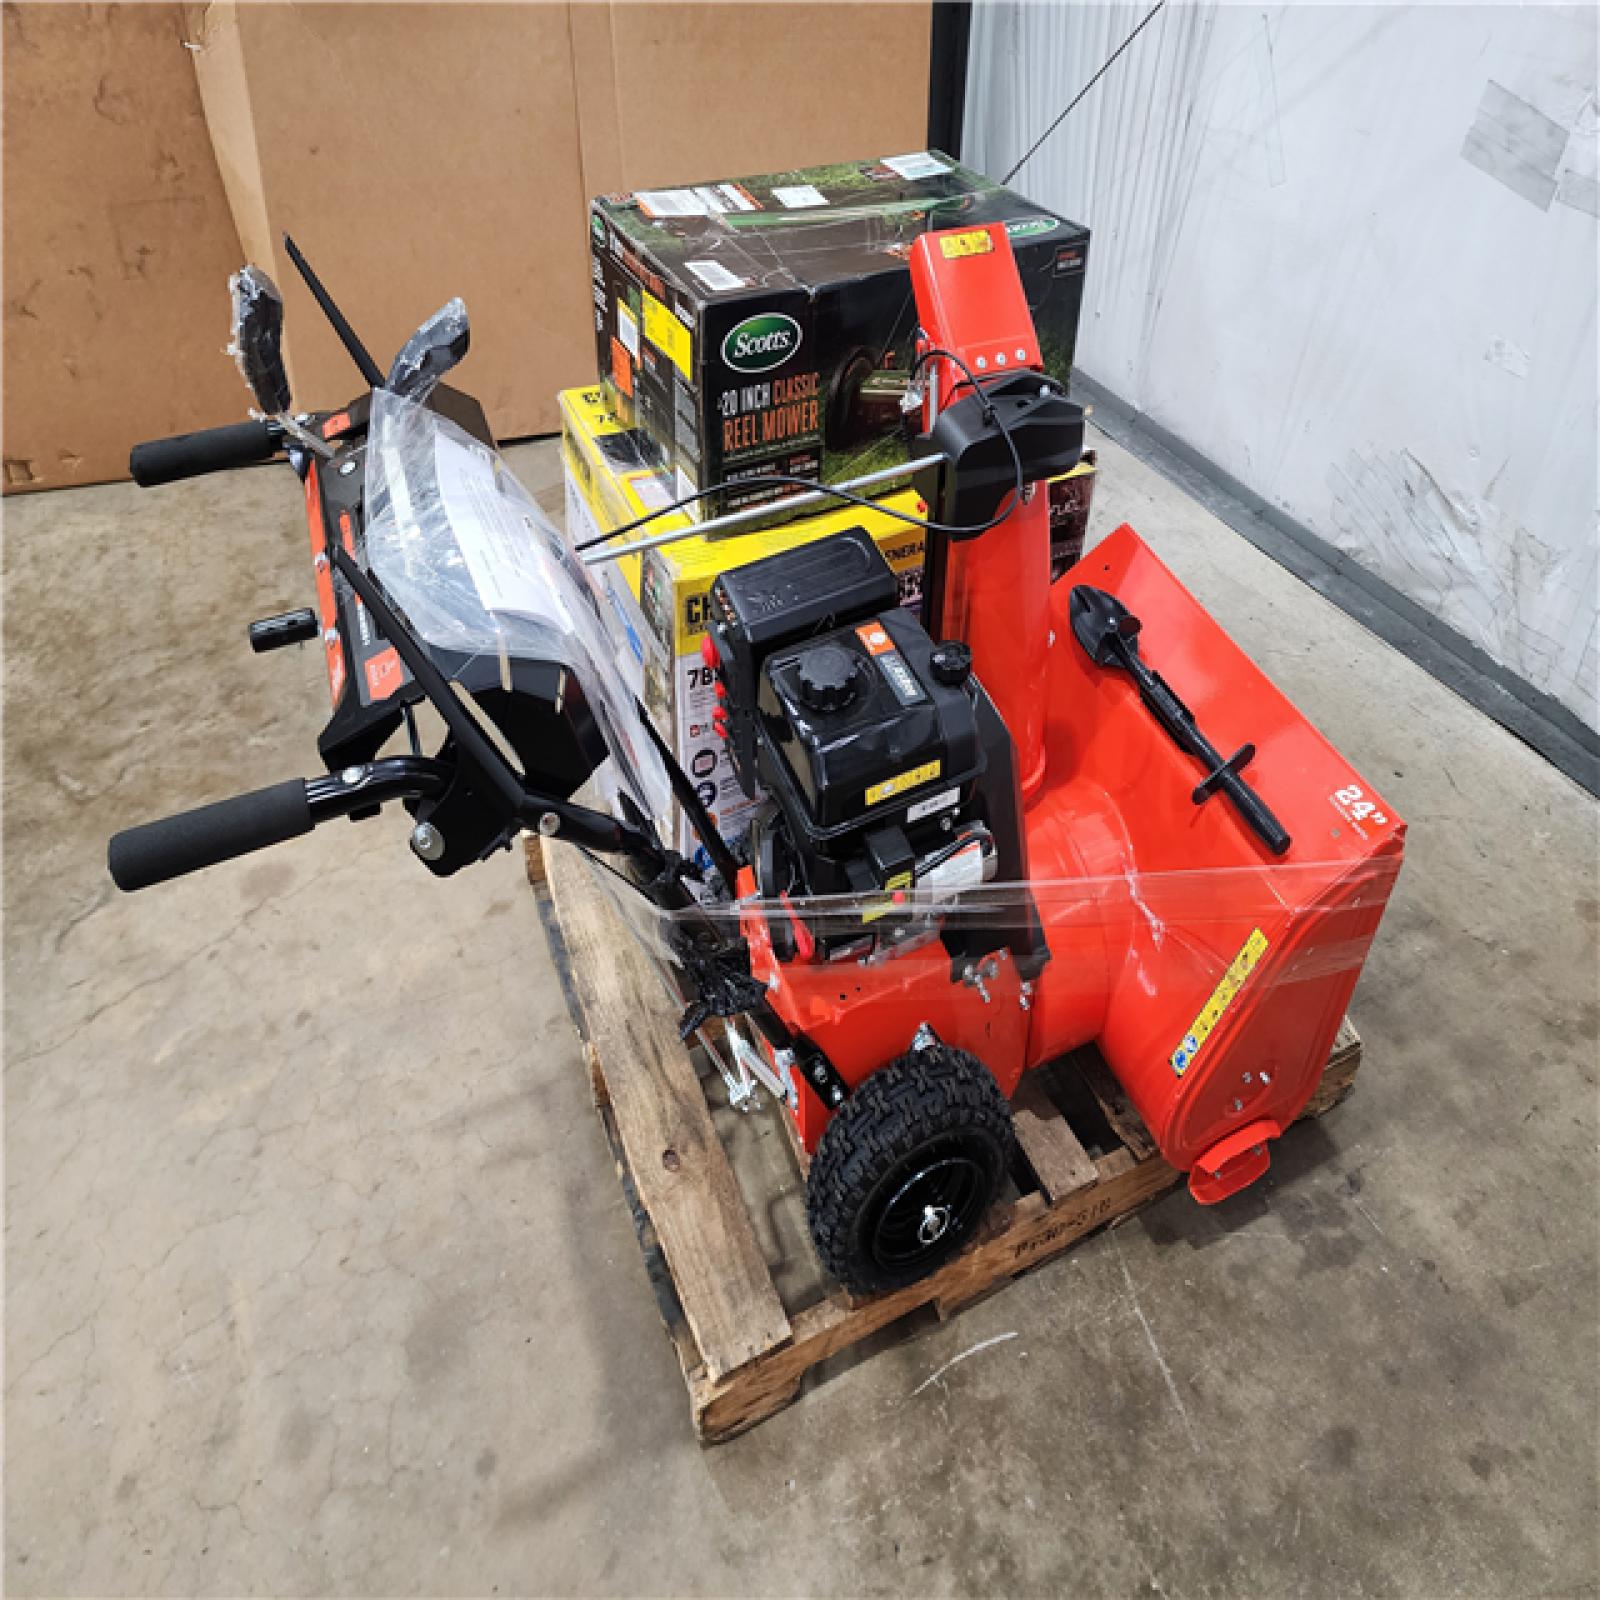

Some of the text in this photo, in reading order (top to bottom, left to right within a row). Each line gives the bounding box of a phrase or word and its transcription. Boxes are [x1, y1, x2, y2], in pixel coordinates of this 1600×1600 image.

[733, 331, 793, 358] Scotts
[721, 371, 821, 417] 20 INCH CLASSIC
[722, 413, 759, 453] REEL
[761, 399, 819, 442] MOWER
